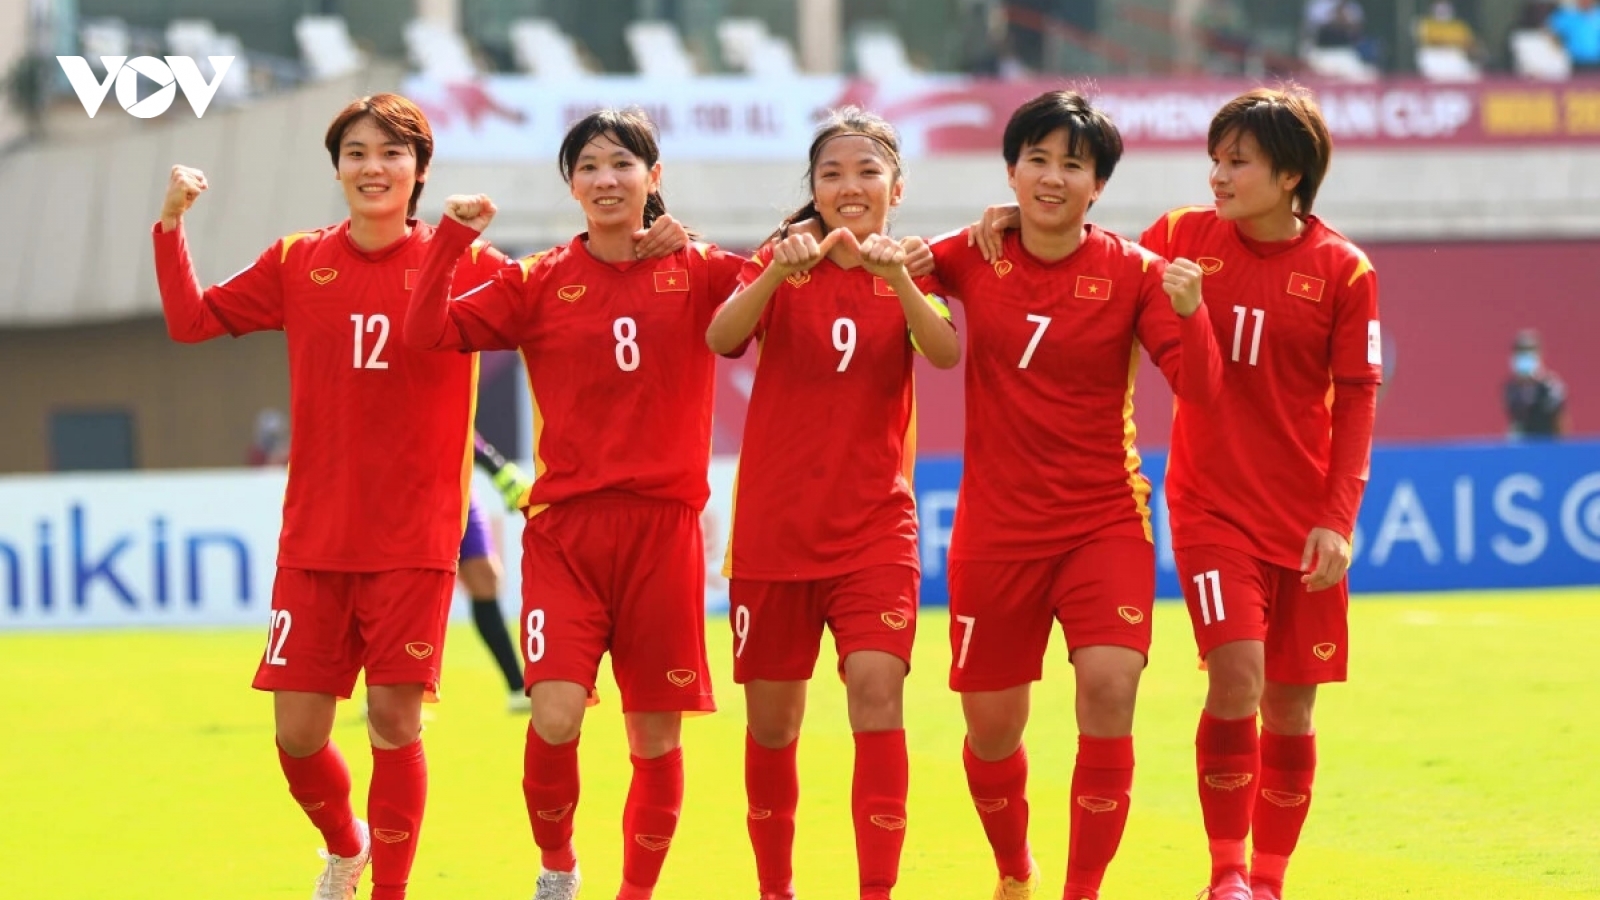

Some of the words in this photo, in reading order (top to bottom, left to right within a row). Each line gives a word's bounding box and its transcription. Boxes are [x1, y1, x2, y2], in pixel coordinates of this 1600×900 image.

[1383, 92, 1471, 137] CUP
[350, 313, 390, 369] 12
[612, 316, 641, 372] 8
[831, 317, 857, 372] 9
[1018, 313, 1052, 369] 7
[1231, 305, 1265, 366] 11
[1193, 569, 1226, 626] 11
[266, 609, 292, 666] 12
[526, 608, 545, 663] 8
[735, 605, 750, 658] 9
[956, 615, 975, 669] 7
